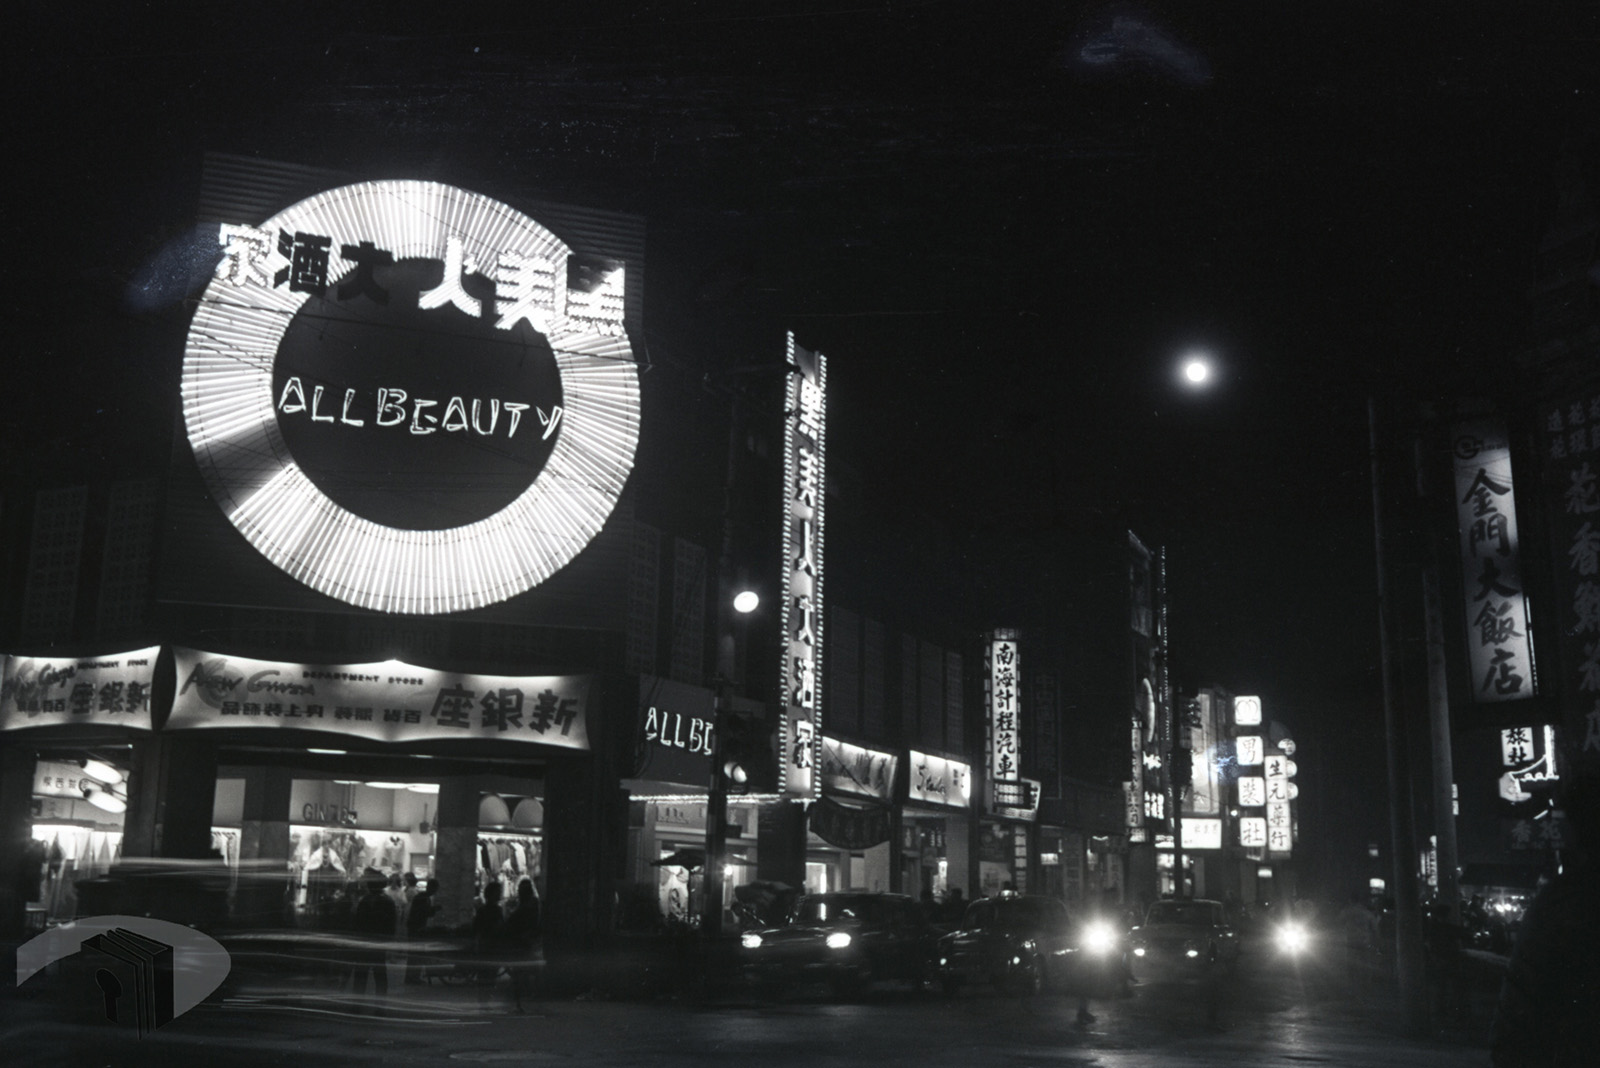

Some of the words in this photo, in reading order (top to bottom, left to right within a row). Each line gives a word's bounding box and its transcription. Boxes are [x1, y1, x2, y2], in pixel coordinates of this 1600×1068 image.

[277, 376, 364, 427] ALL
[375, 387, 563, 441] BEAUTY
[1461, 468, 1525, 694] 金門大飯店
[303, 671, 380, 682] DEPARTMENT
[388, 676, 424, 686] STORE
[430, 683, 579, 736] 新銀座
[644, 706, 686, 748] ALL
[995, 643, 1016, 779] 南海計程汽車
